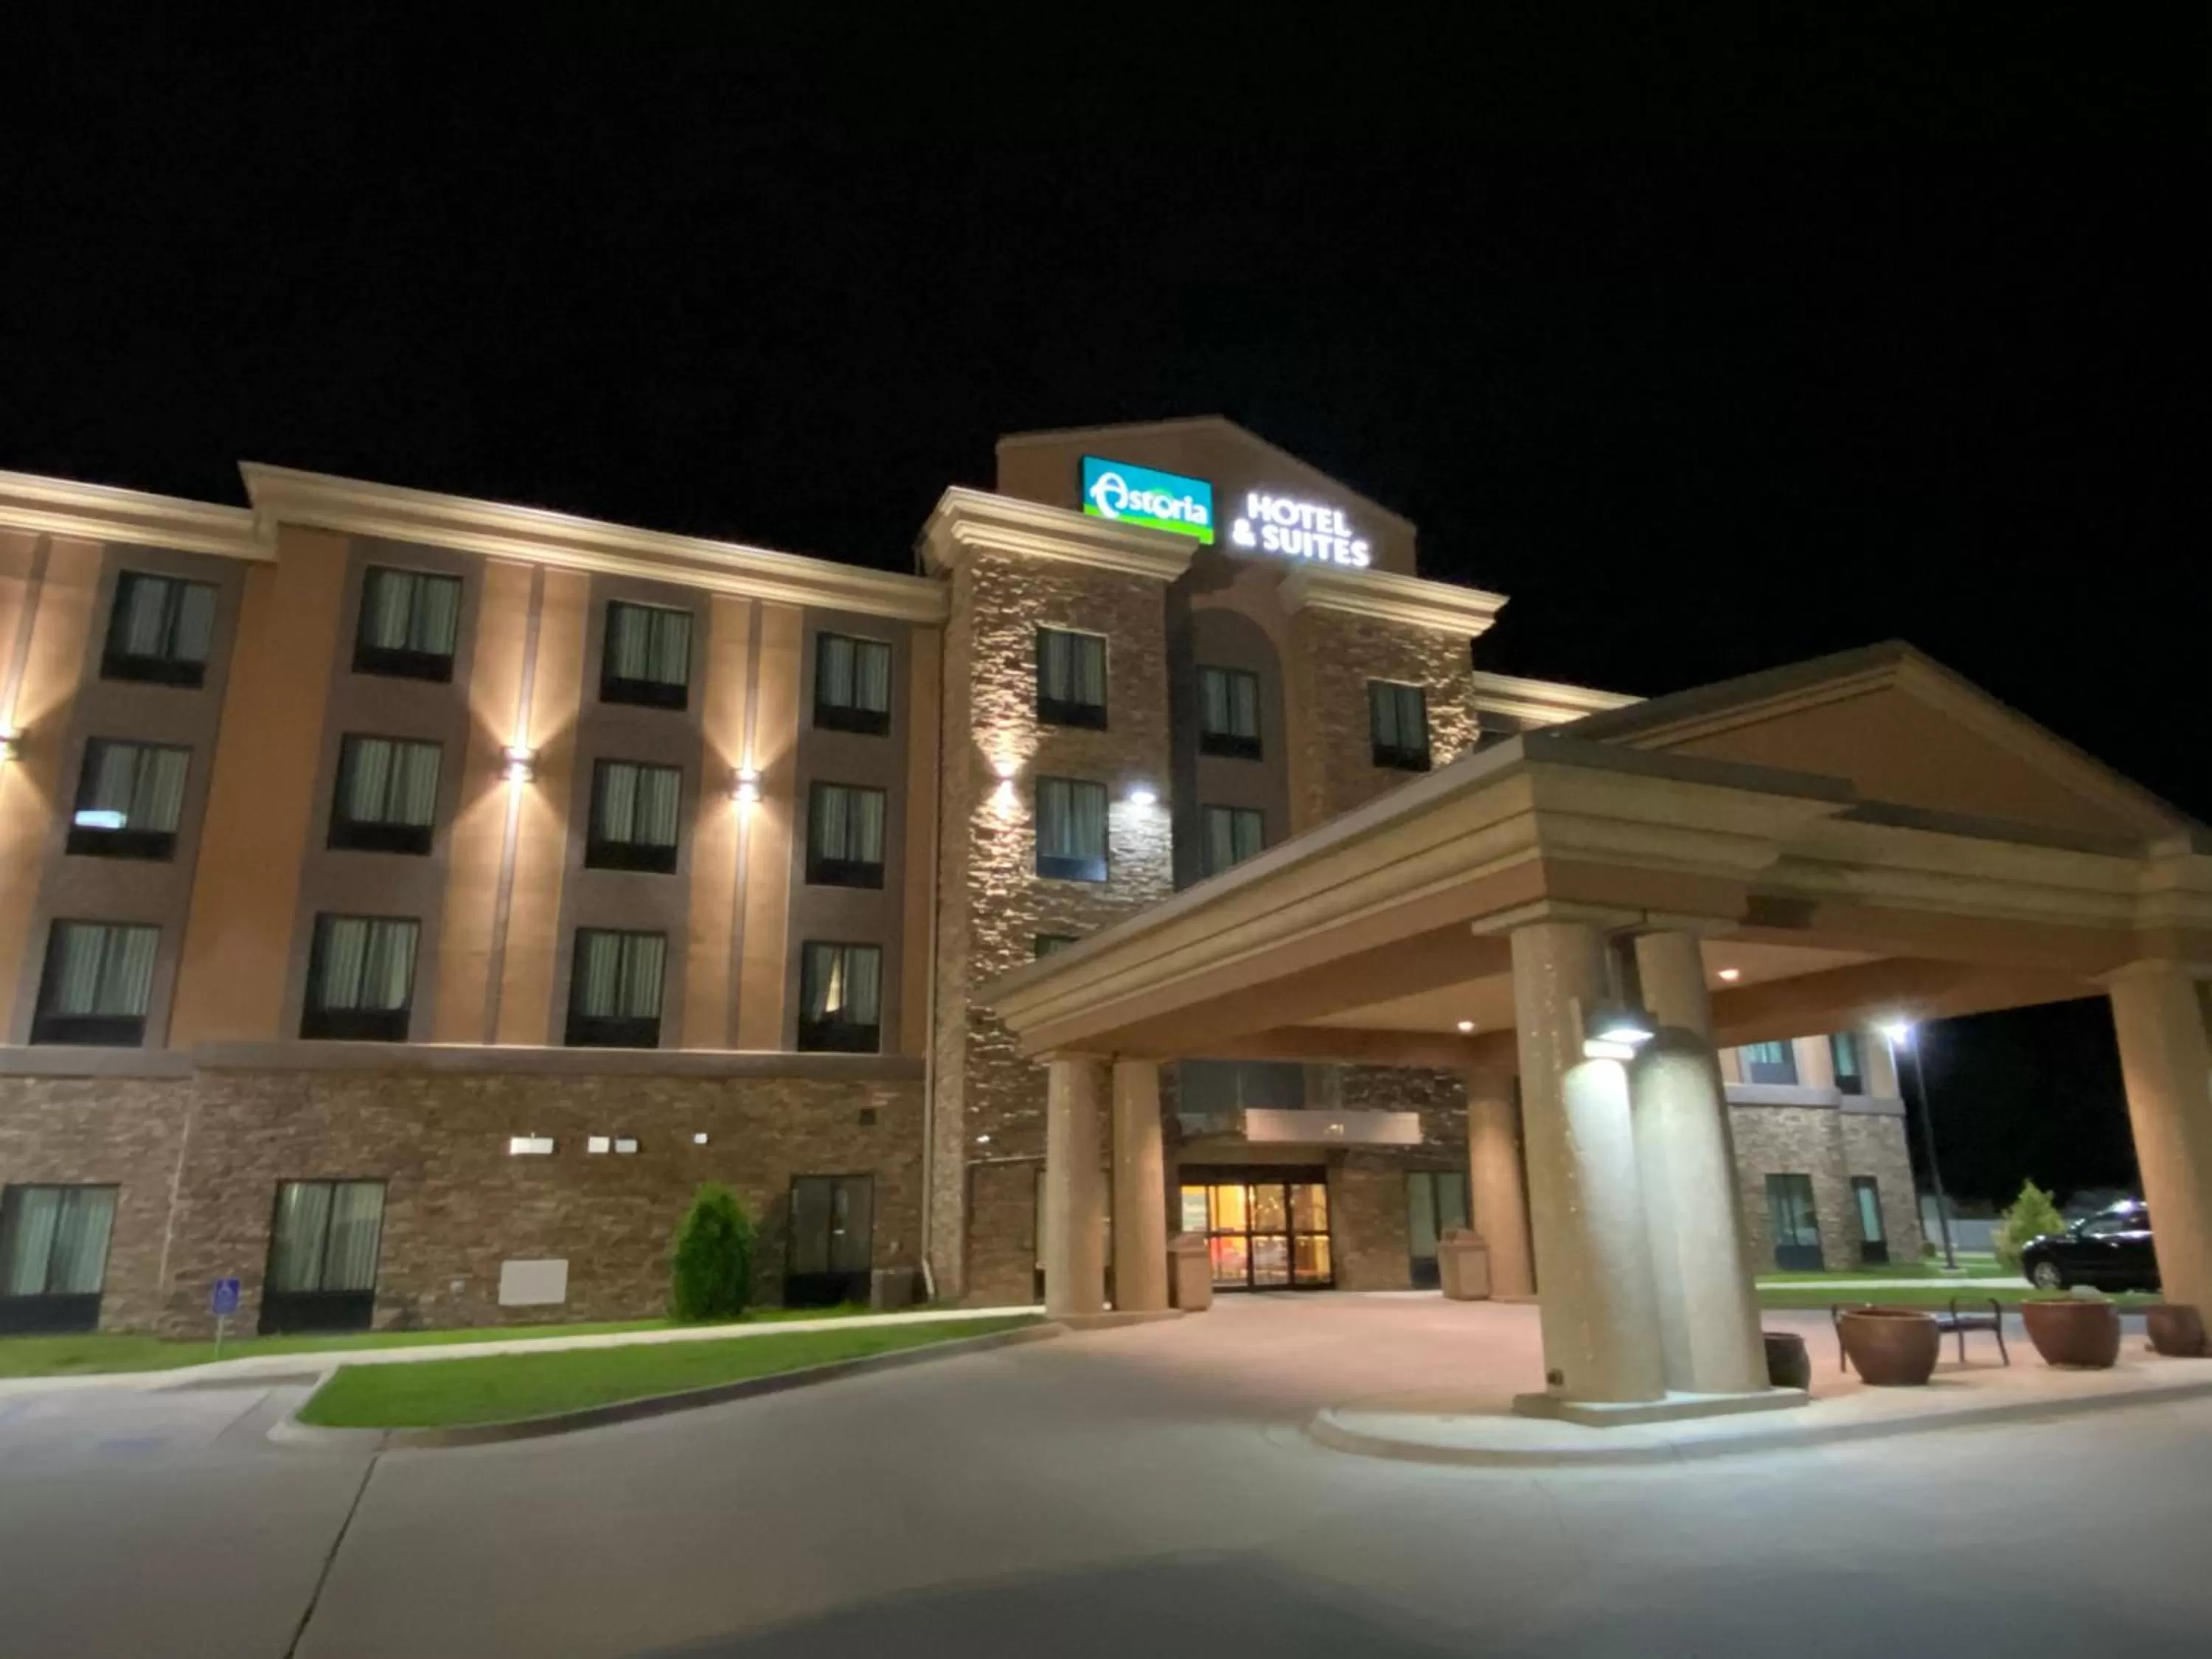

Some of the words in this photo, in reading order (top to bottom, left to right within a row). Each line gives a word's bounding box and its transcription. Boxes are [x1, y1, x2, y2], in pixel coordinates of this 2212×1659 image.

[1090, 472, 1208, 525] Astoria
[1247, 493, 1352, 537] HOTEL
[1232, 519, 1254, 546] &
[1262, 525, 1370, 567] SUITES
